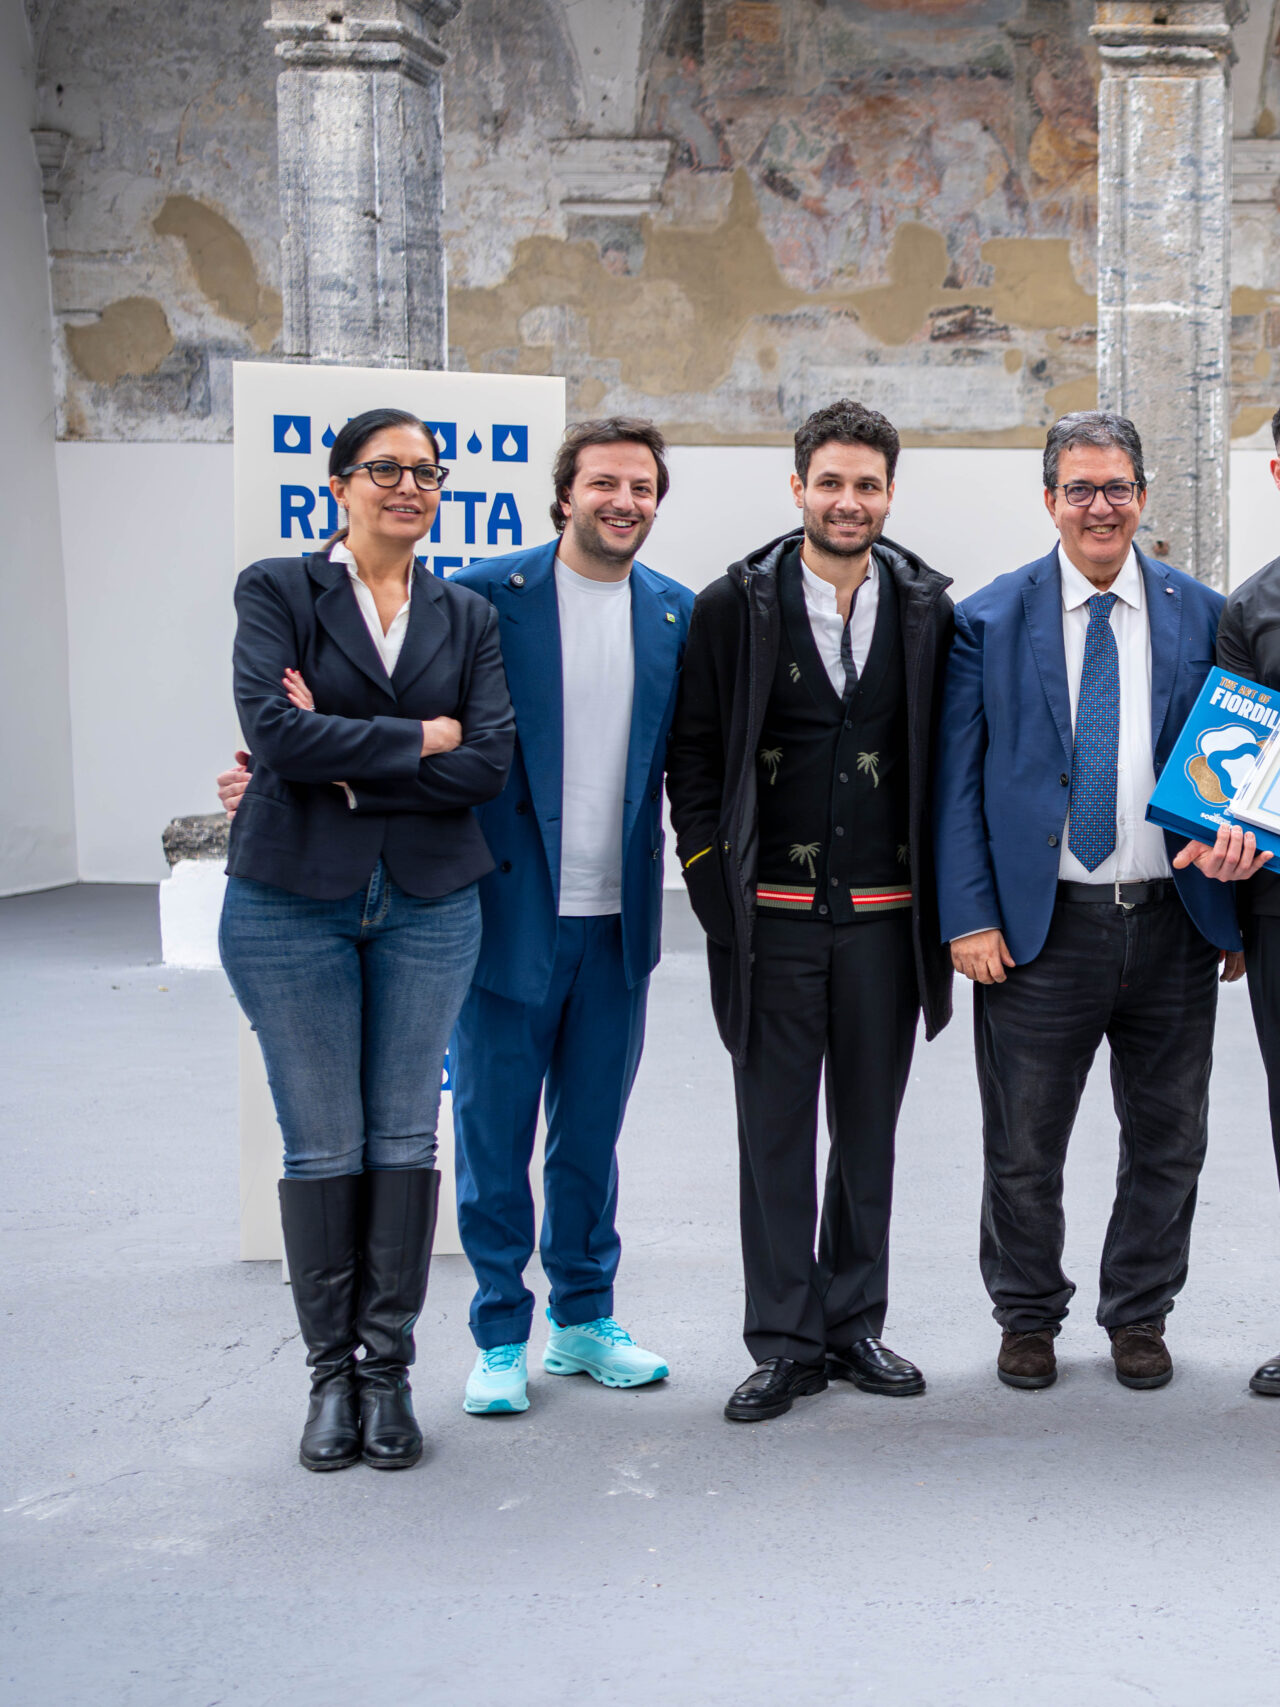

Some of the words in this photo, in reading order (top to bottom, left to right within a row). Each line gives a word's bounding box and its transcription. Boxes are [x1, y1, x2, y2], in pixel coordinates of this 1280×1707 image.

[280, 484, 522, 546] RITTA
[1209, 686, 1279, 729] FIORDIL
[1219, 676, 1239, 691] THE
[1238, 685, 1258, 699] ART
[1258, 693, 1272, 704] OF
